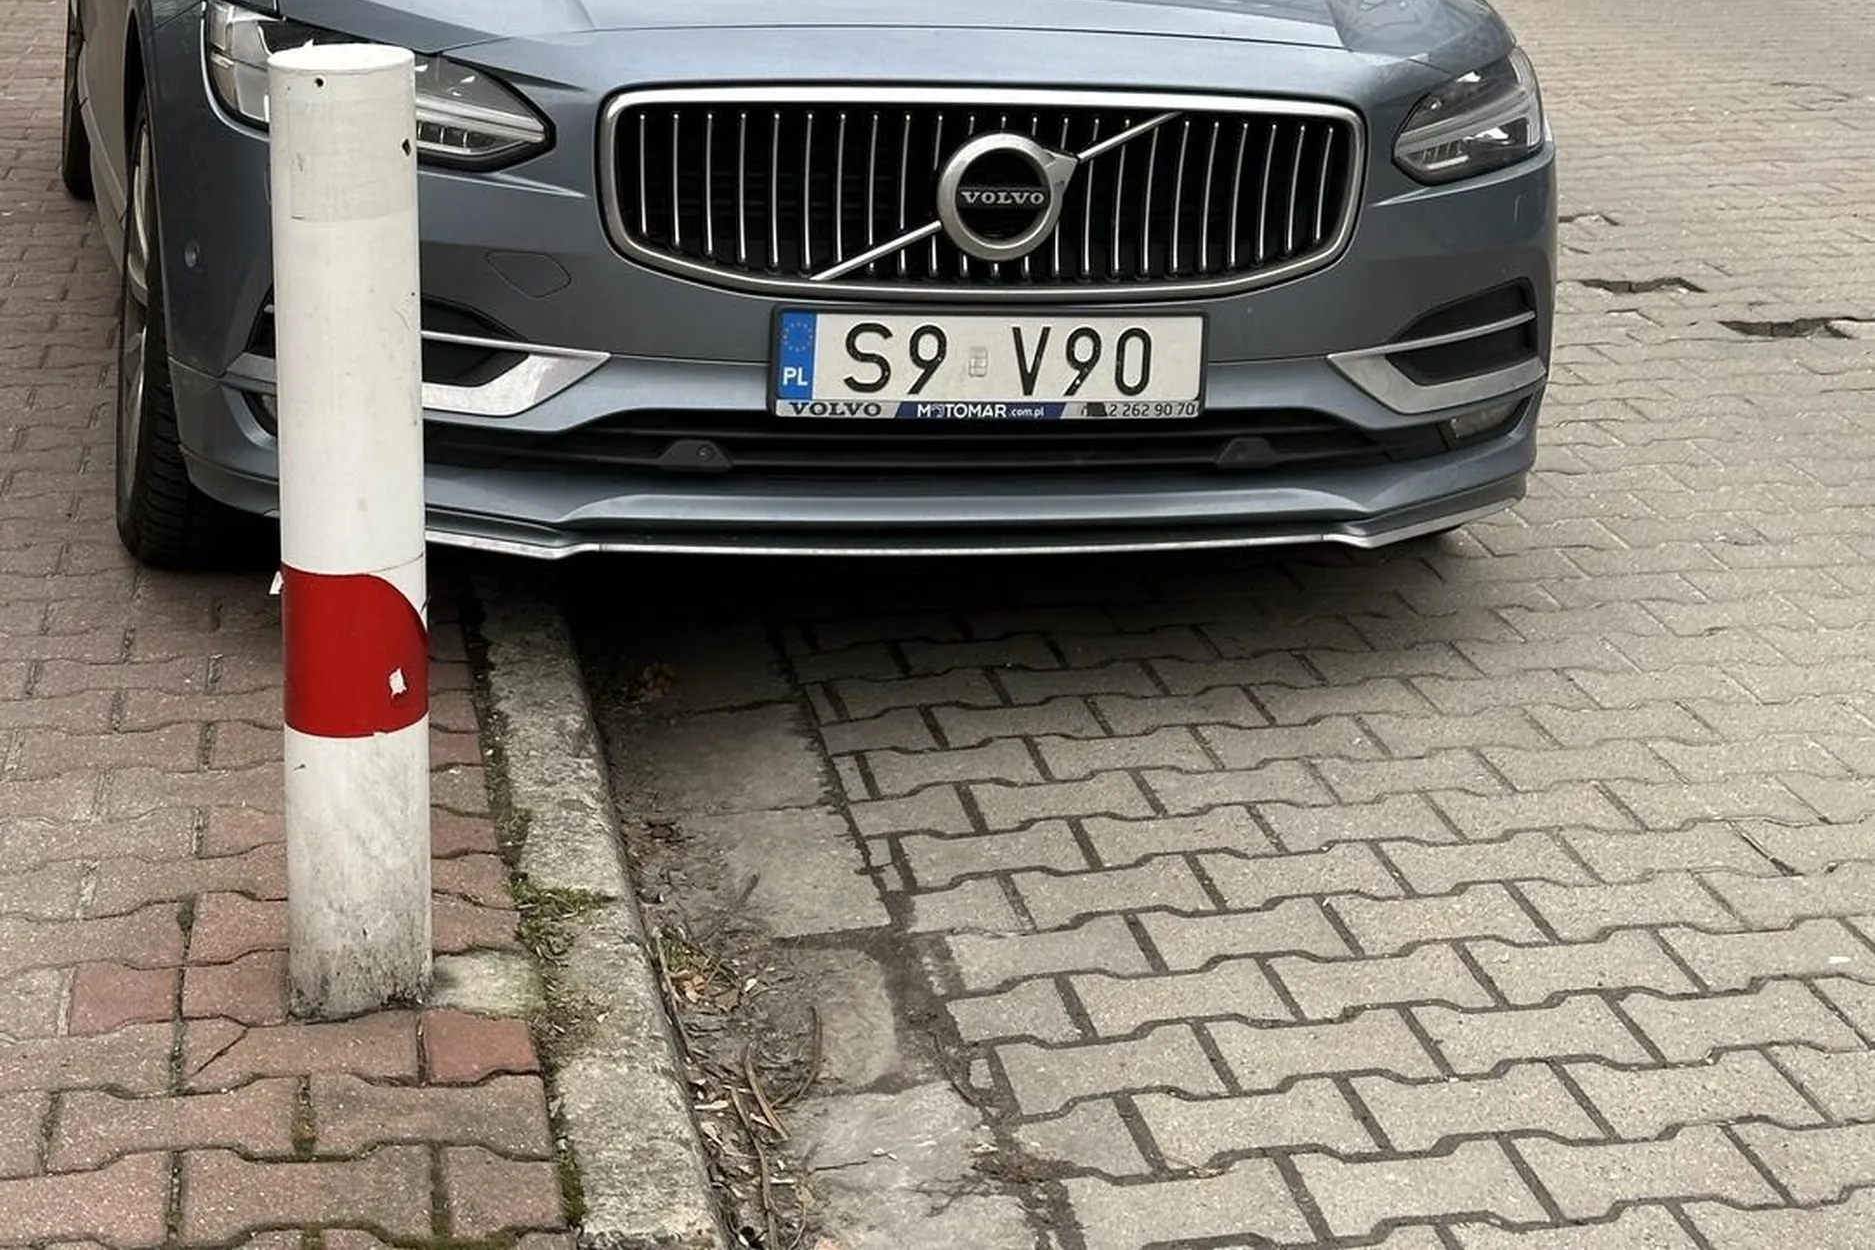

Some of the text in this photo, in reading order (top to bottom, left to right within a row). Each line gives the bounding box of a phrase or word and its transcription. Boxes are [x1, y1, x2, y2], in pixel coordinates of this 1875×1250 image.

[961, 191, 1045, 205] VOLVO
[843, 322, 1152, 396] S9 V90
[782, 367, 808, 386] PL
[789, 402, 882, 417] VOLVO
[1122, 403, 1151, 417] 262
[1154, 403, 1173, 416] 90
